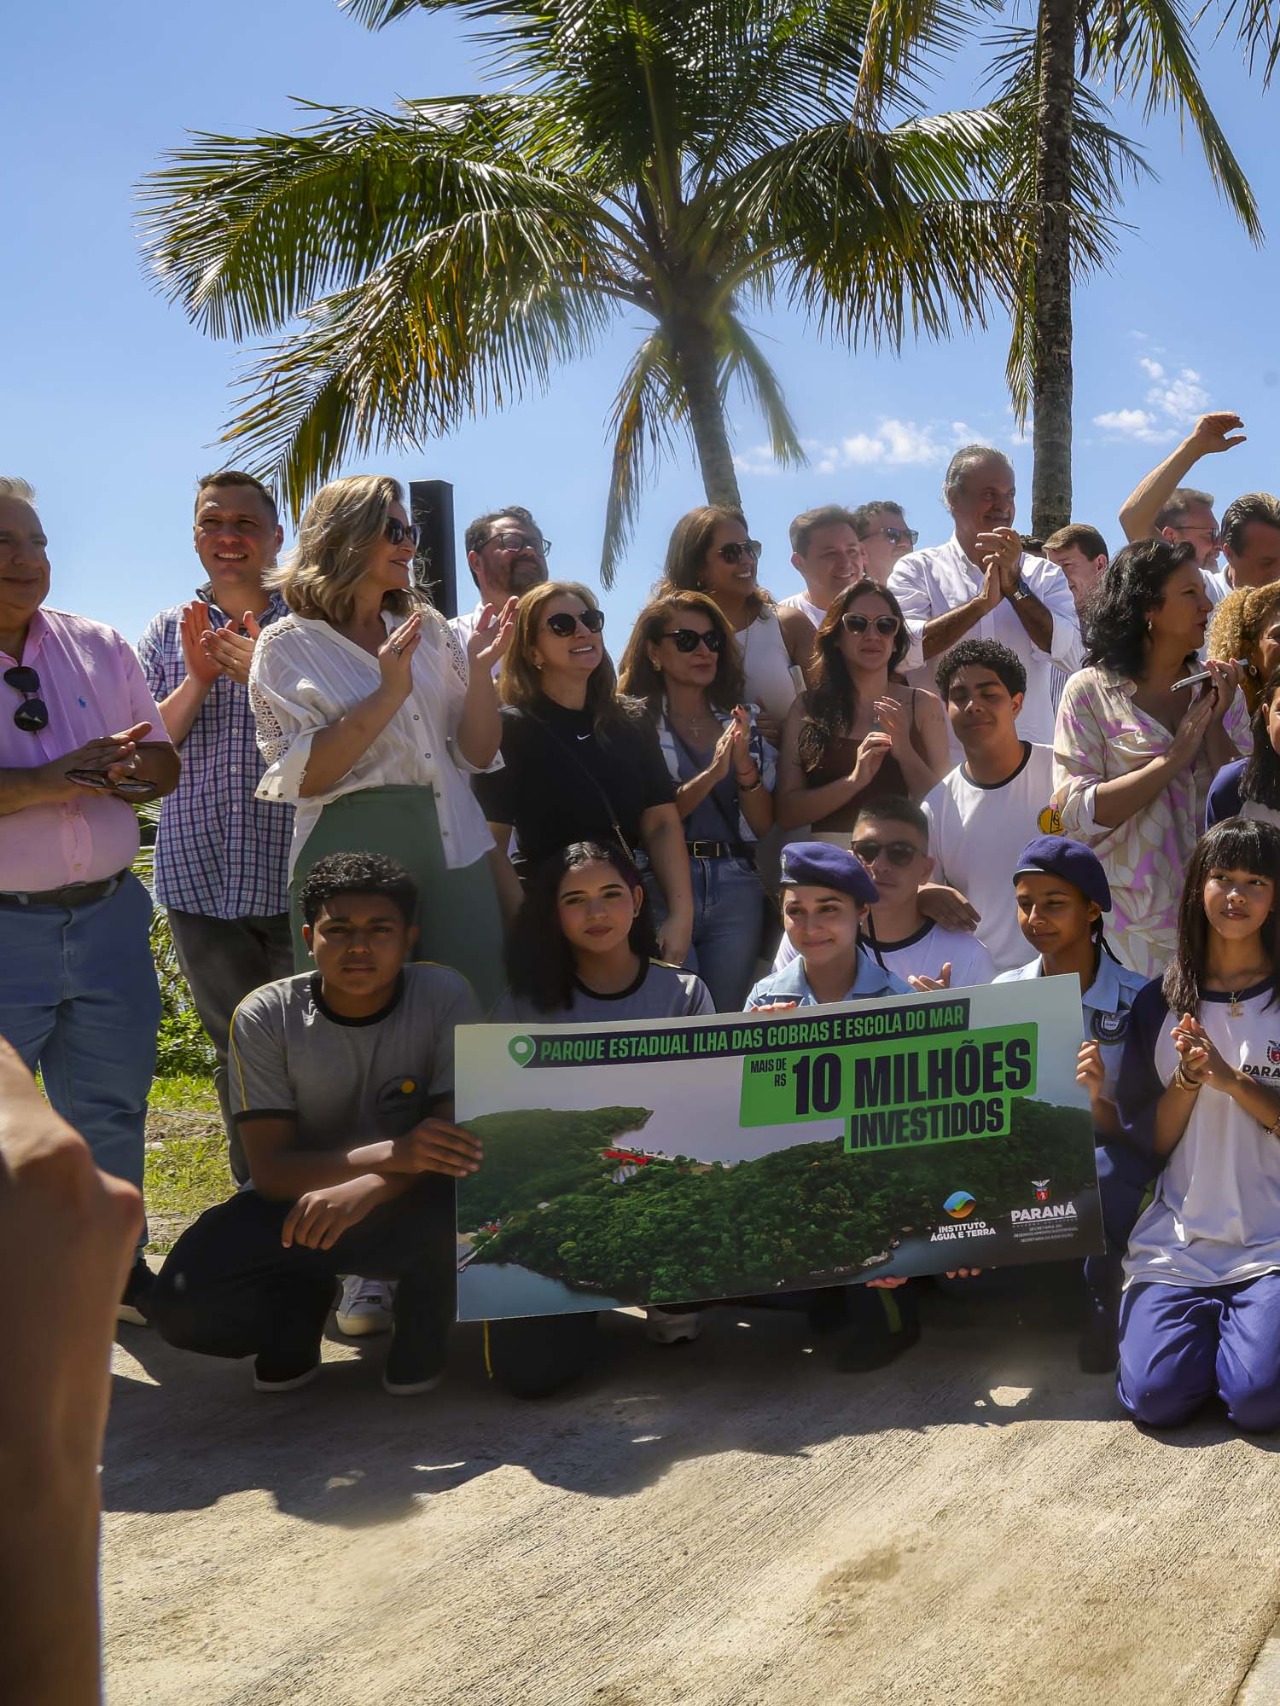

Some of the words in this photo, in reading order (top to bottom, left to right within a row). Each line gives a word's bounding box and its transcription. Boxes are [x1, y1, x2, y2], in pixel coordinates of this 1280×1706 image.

[540, 1039, 604, 1062] PARQUE
[609, 1034, 689, 1059] ESTADUAL
[693, 1031, 728, 1053] ILHA
[732, 1028, 763, 1051] DAS
[767, 1021, 829, 1047] COBRAS
[833, 1020, 842, 1040] E
[845, 1013, 901, 1039] ESCOLA
[905, 1009, 925, 1030] DO
[929, 1004, 964, 1028] MAR
[750, 1059, 775, 1074] MAIS
[776, 1058, 787, 1071] DE
[792, 1052, 842, 1115] 10
[854, 1038, 1031, 1109] MILHÕES
[850, 1097, 1004, 1149] INVESTIDOS
[1010, 1202, 1078, 1222] PARANÁ
[930, 1231, 955, 1241] ÁGUA
[966, 1228, 996, 1237] TERRA
[939, 1222, 986, 1233] INSTITUTO
